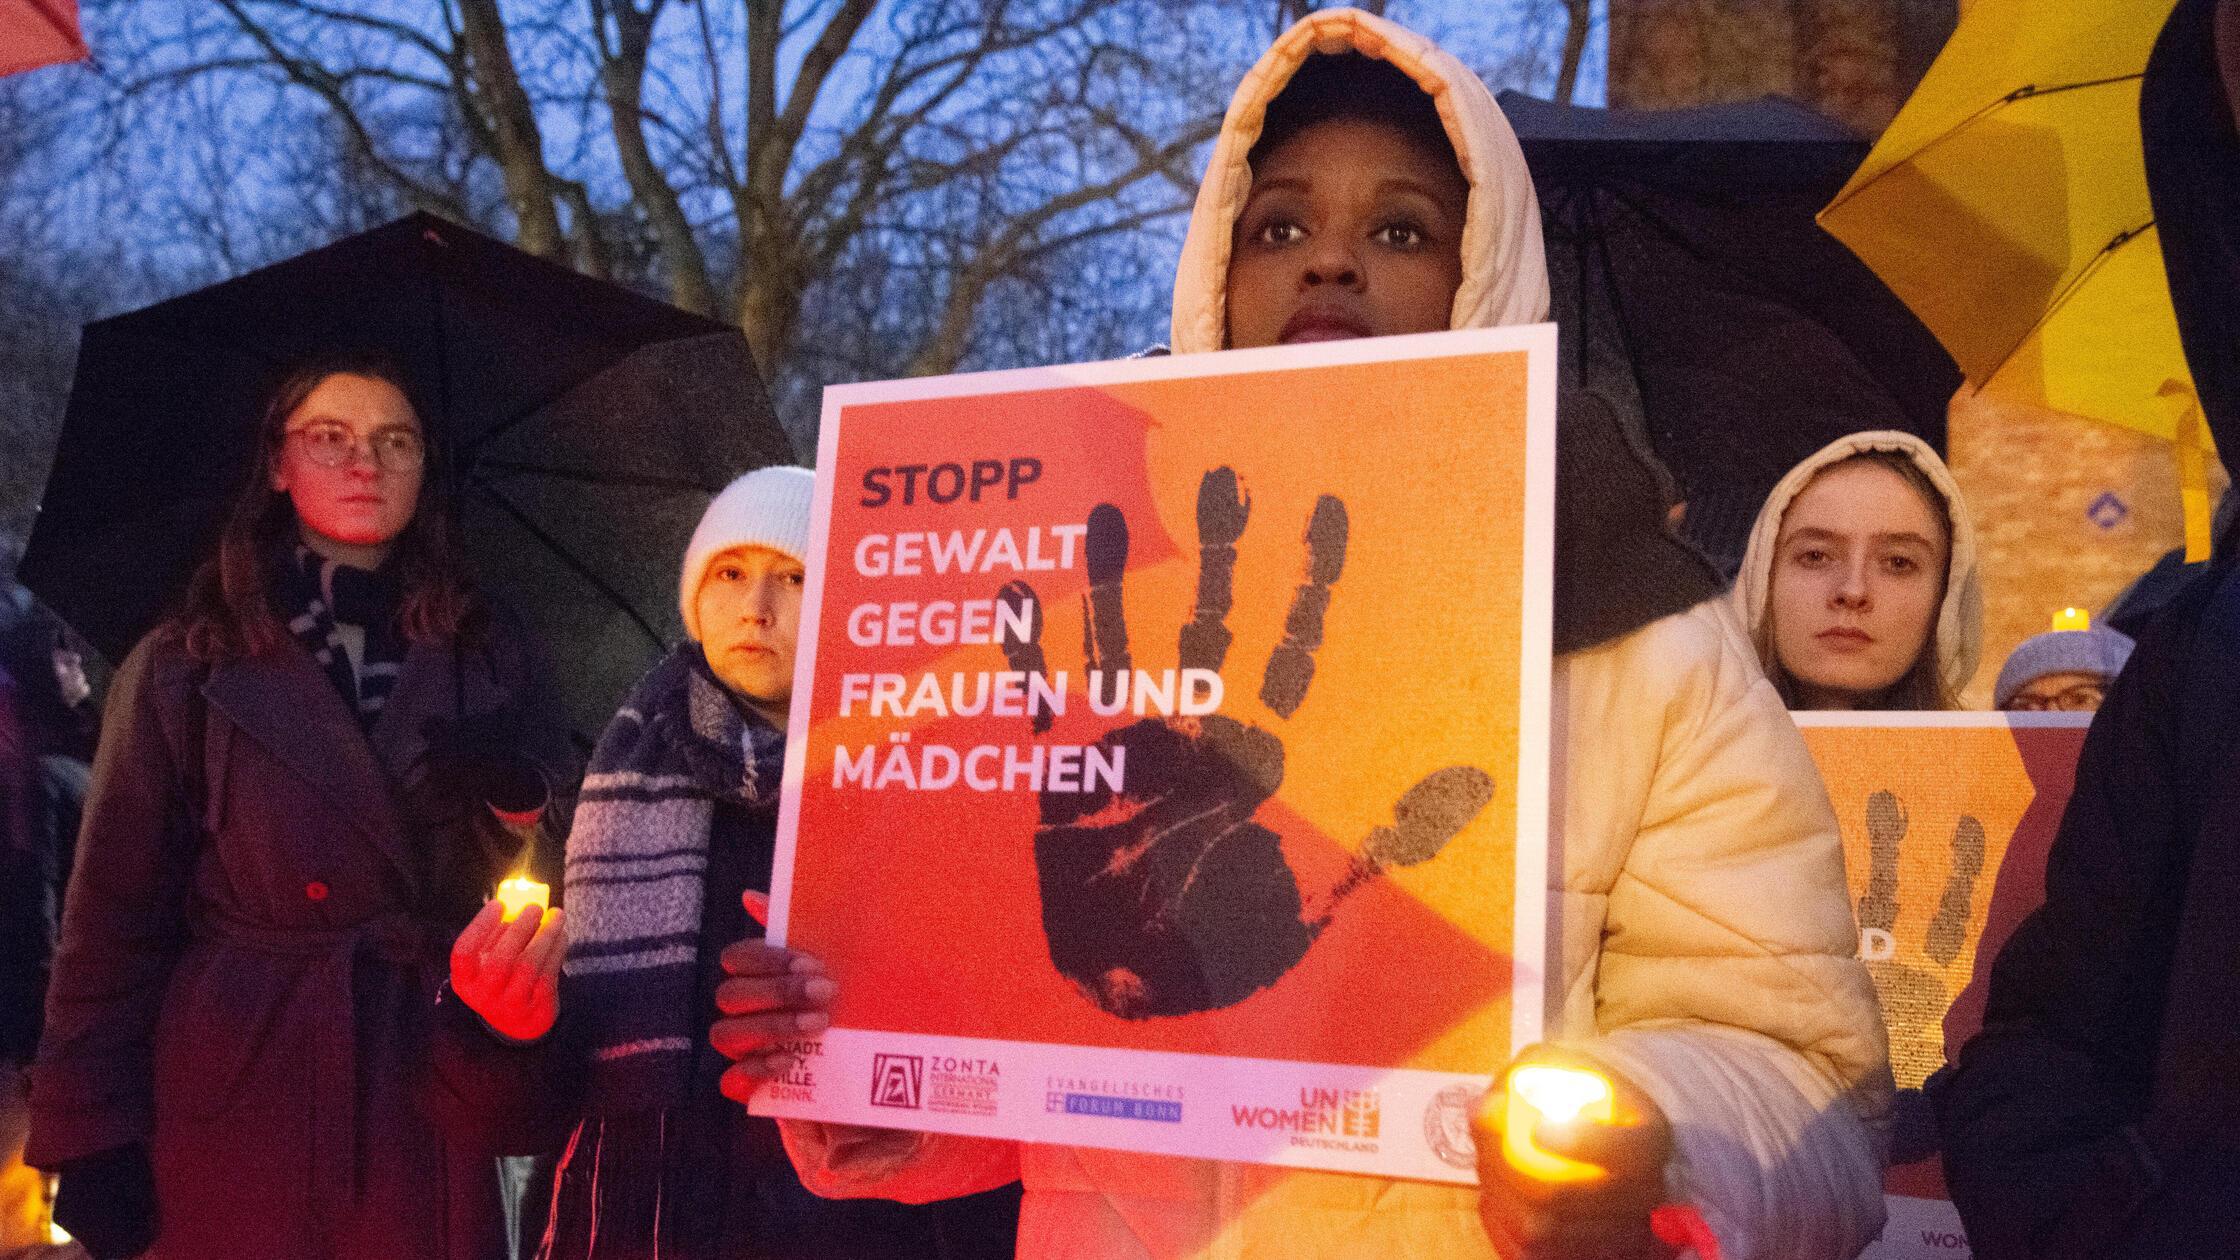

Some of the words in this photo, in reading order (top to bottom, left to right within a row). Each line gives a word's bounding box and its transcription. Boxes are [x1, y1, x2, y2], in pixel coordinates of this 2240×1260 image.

[861, 457, 1042, 508] STOPP
[854, 524, 1088, 577] GEWALT
[847, 598, 1034, 647] GEGEN
[838, 670, 1068, 718] FRAUEN
[1088, 668, 1225, 717] UND
[832, 732, 1126, 793] MÄDCHEN
[931, 1056, 1000, 1076] ZONTA
[1047, 1077, 1184, 1100] EVANGELISCHES
[1301, 1087, 1338, 1108] UN
[1232, 1104, 1337, 1133] WOMEN
[1290, 1136, 1380, 1153] DEUTSCHLAND
